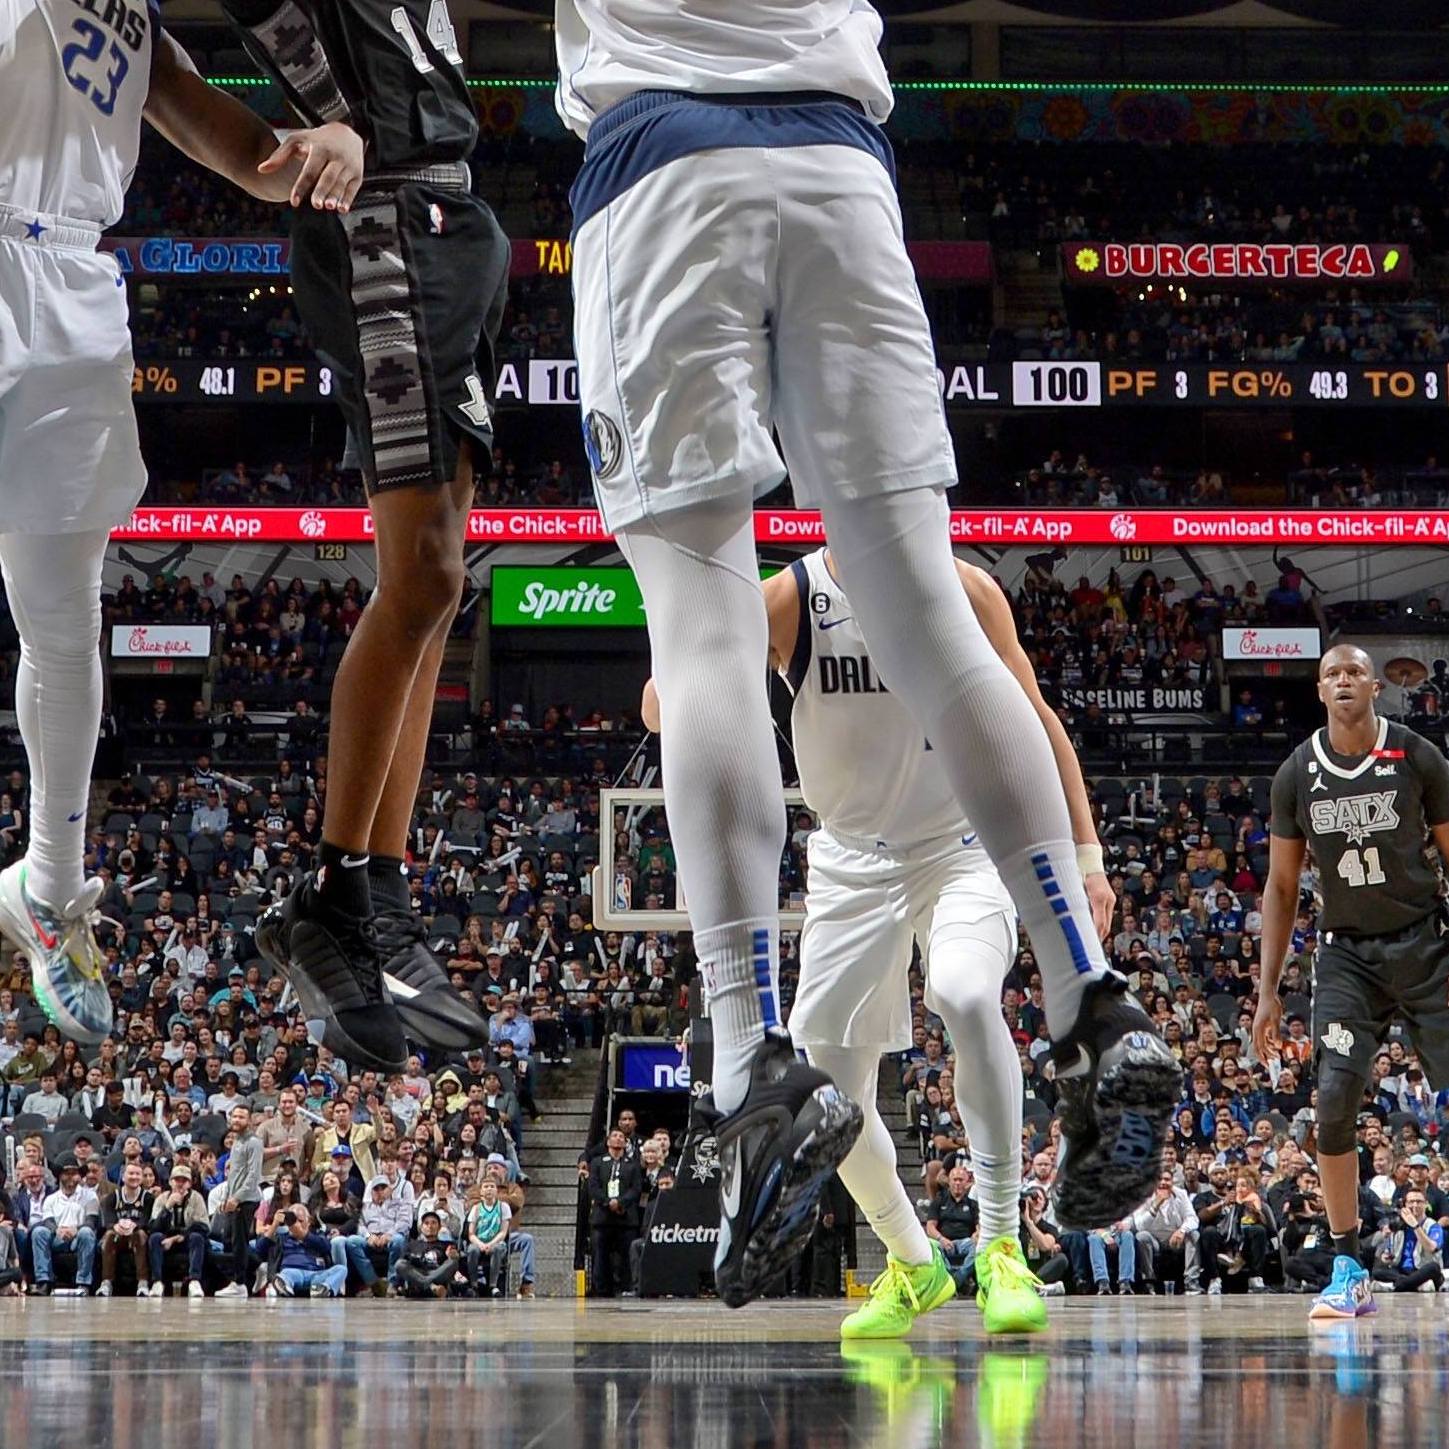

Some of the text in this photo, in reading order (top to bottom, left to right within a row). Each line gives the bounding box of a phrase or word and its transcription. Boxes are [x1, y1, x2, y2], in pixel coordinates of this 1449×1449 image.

[61, 18, 129, 117] 23
[139, 238, 291, 274] GLORI
[1105, 244, 1375, 277] BURGERTECA
[199, 367, 235, 396] 48.1
[256, 368, 306, 393] PF
[319, 367, 333, 396] 3
[1031, 367, 1089, 401] 100
[1108, 372, 1157, 396] PF
[1175, 371, 1188, 399] 3
[1208, 371, 1292, 397] FG%
[1309, 371, 1348, 400] 49.3
[1365, 371, 1415, 398] TO
[1426, 371, 1438, 399] 3
[109, 512, 261, 535] hick-fil-A App
[470, 515, 602, 535] the Chick-fil-
[950, 517, 1072, 540] ck-fil-A App
[1173, 517, 1273, 537] Download
[1276, 517, 1312, 536] the
[316, 544, 345, 559] 128
[1122, 547, 1151, 562] 101
[518, 580, 616, 618] Sprite
[815, 595, 826, 611] 6
[818, 655, 889, 694] DAL
[1153, 688, 1204, 709] BUMS
[1310, 790, 1401, 835] SATX
[1337, 847, 1386, 887] 41
[650, 1224, 721, 1244] ticketm
